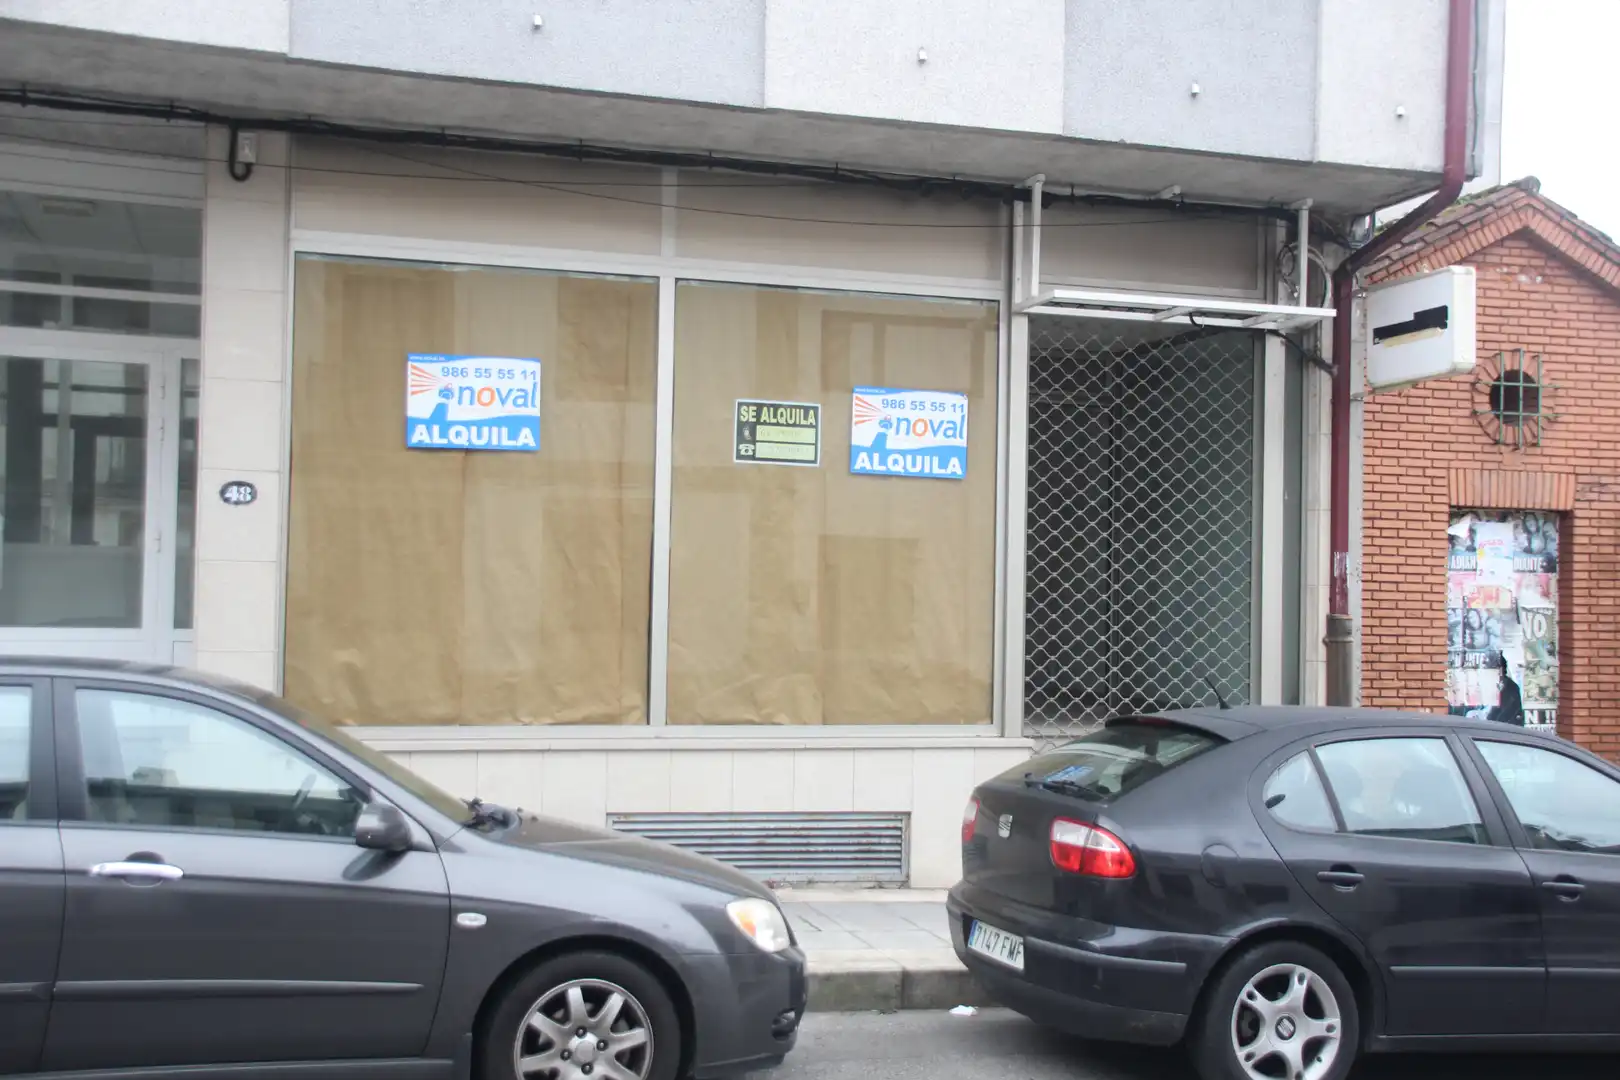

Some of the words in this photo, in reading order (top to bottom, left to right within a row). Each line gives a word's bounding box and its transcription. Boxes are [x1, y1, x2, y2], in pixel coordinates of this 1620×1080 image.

[441, 366, 469, 378] 986
[474, 367, 492, 379] 55
[497, 368, 515, 380] 55
[520, 369, 537, 381] 11
[457, 381, 538, 409] noval
[882, 398, 905, 409] 986
[910, 400, 926, 411] 55
[930, 401, 946, 412] 55
[951, 403, 965, 413] 11
[740, 405, 757, 422] SE
[760, 406, 816, 425] ALQUILA
[411, 424, 537, 447] ALQUILA
[895, 414, 966, 440] noval
[854, 451, 963, 475] ALQUILA
[224, 485, 252, 502] 48
[1521, 611, 1548, 641] NO
[975, 924, 1001, 953] 7147
